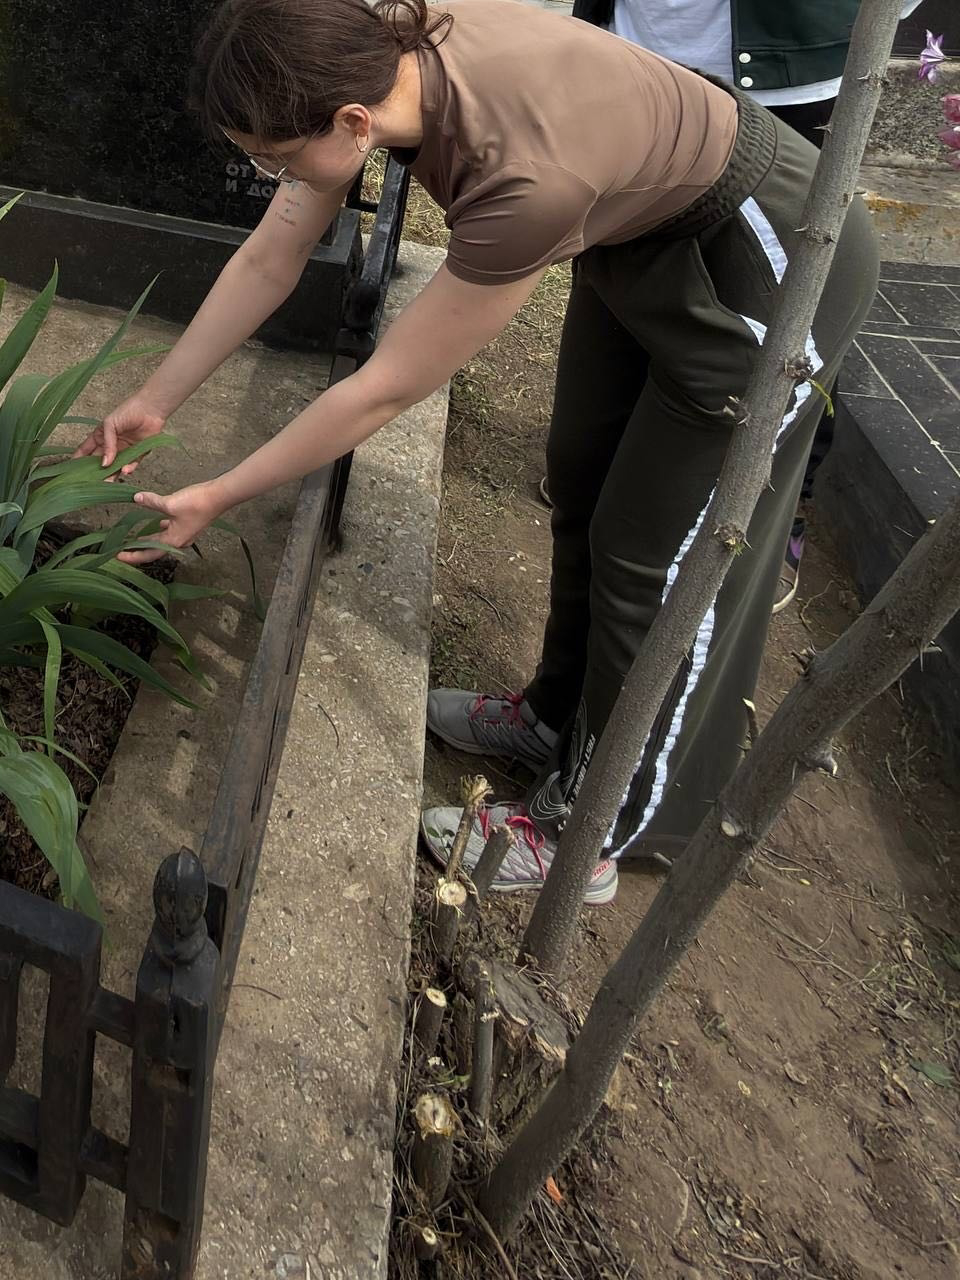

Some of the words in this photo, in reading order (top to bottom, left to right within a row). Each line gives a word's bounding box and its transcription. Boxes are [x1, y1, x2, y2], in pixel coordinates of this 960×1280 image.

[225, 164, 251, 178] ОТ
[225, 179, 238, 193] И
[247, 183, 277, 199] ДО
